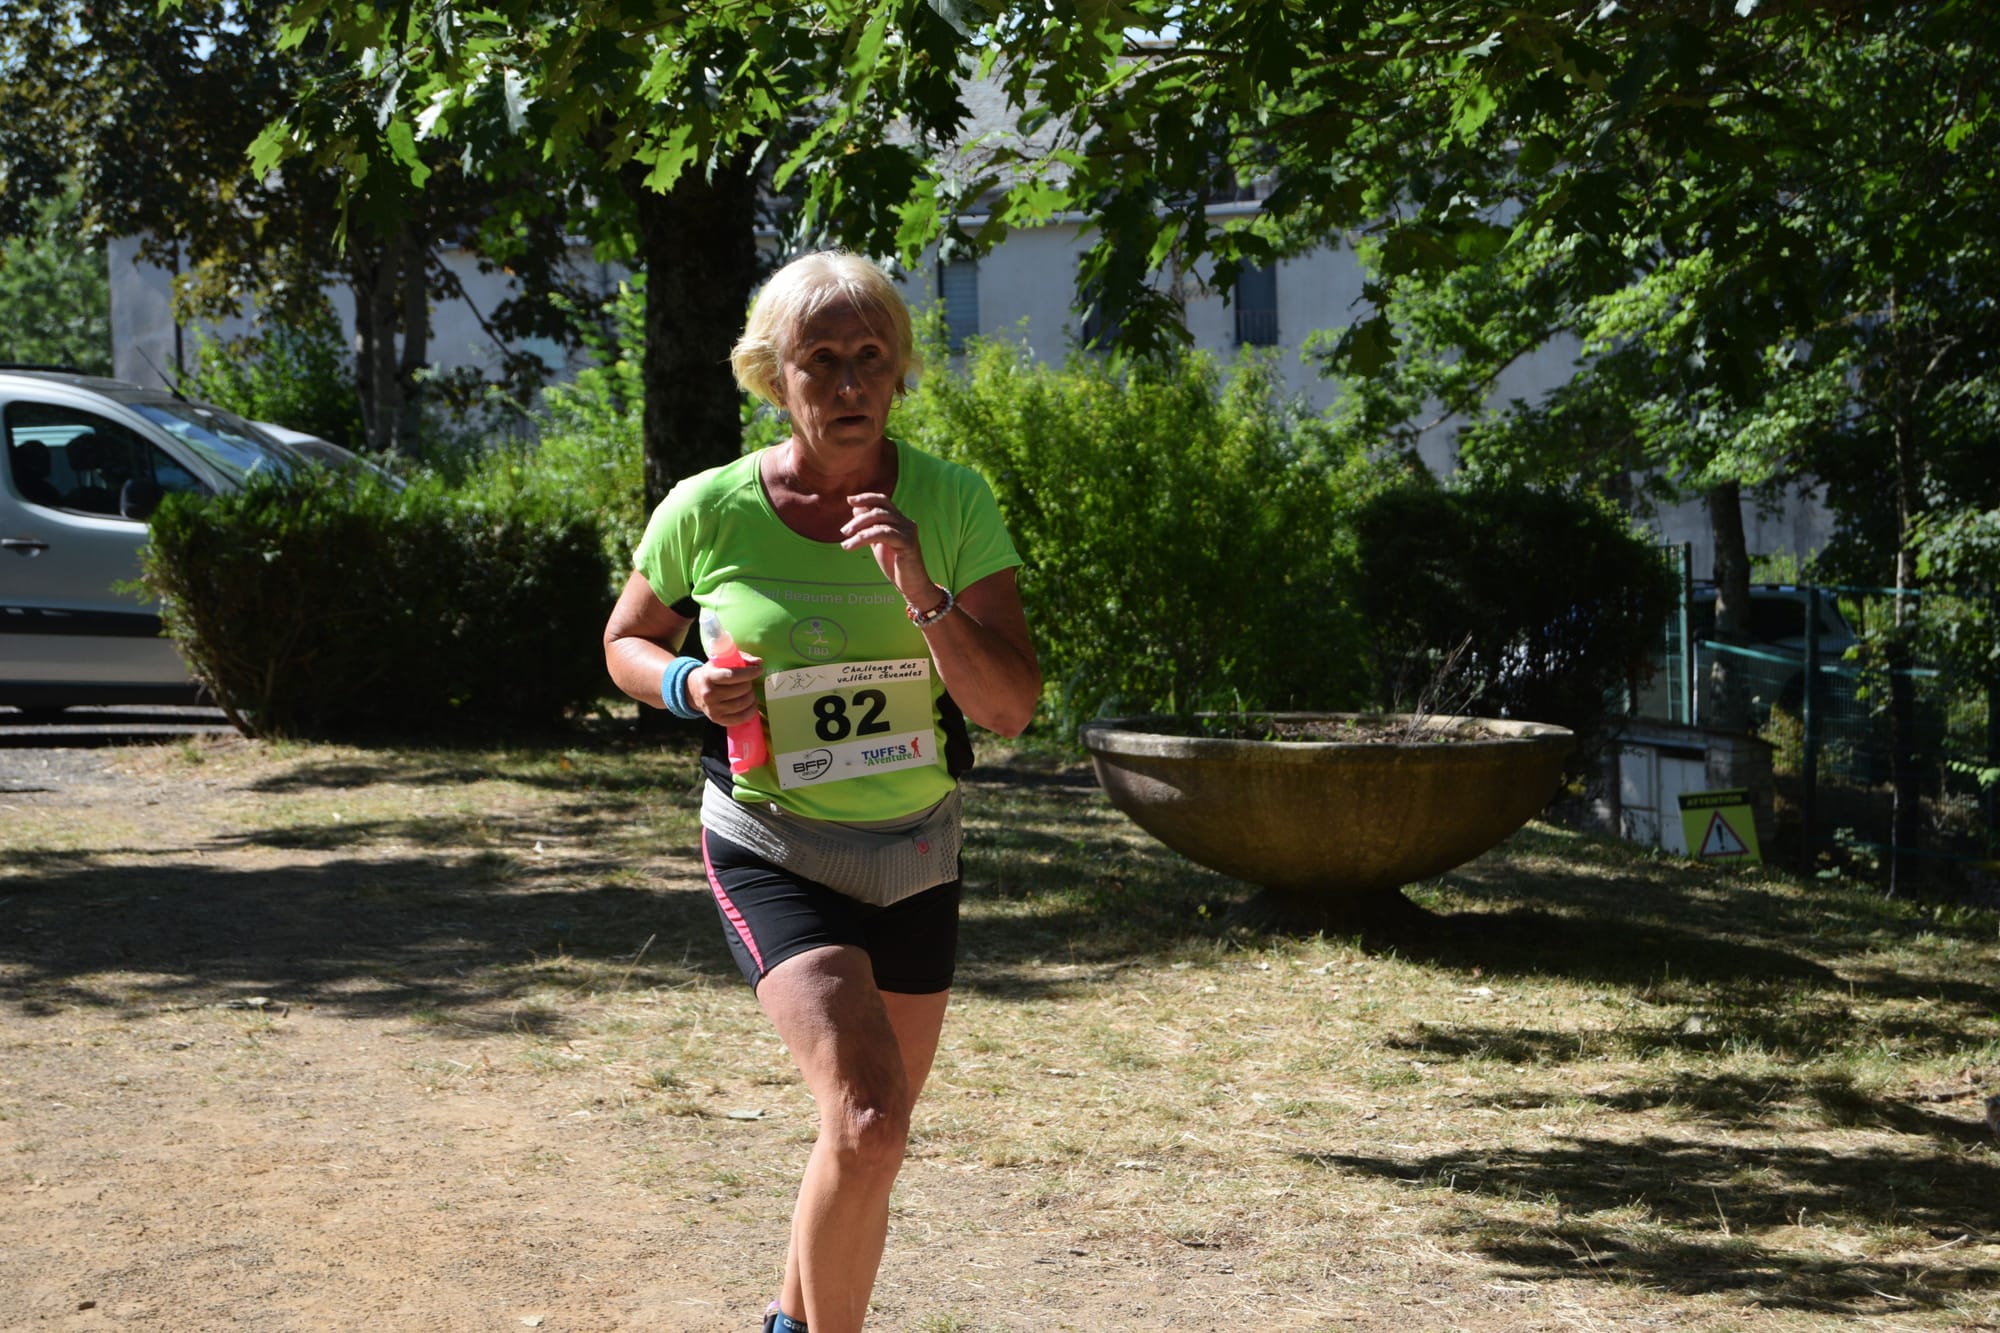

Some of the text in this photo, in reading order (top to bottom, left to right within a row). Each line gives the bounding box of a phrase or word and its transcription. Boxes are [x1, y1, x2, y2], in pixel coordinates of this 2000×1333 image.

[784, 590, 843, 604] Beaume
[848, 592, 896, 605] Drobie
[842, 662, 916, 674] Challenge des
[813, 689, 890, 742] 82
[861, 745, 907, 760] TUFF'S
[793, 758, 828, 773] BFP
[1686, 795, 1742, 807] ATTENTION
